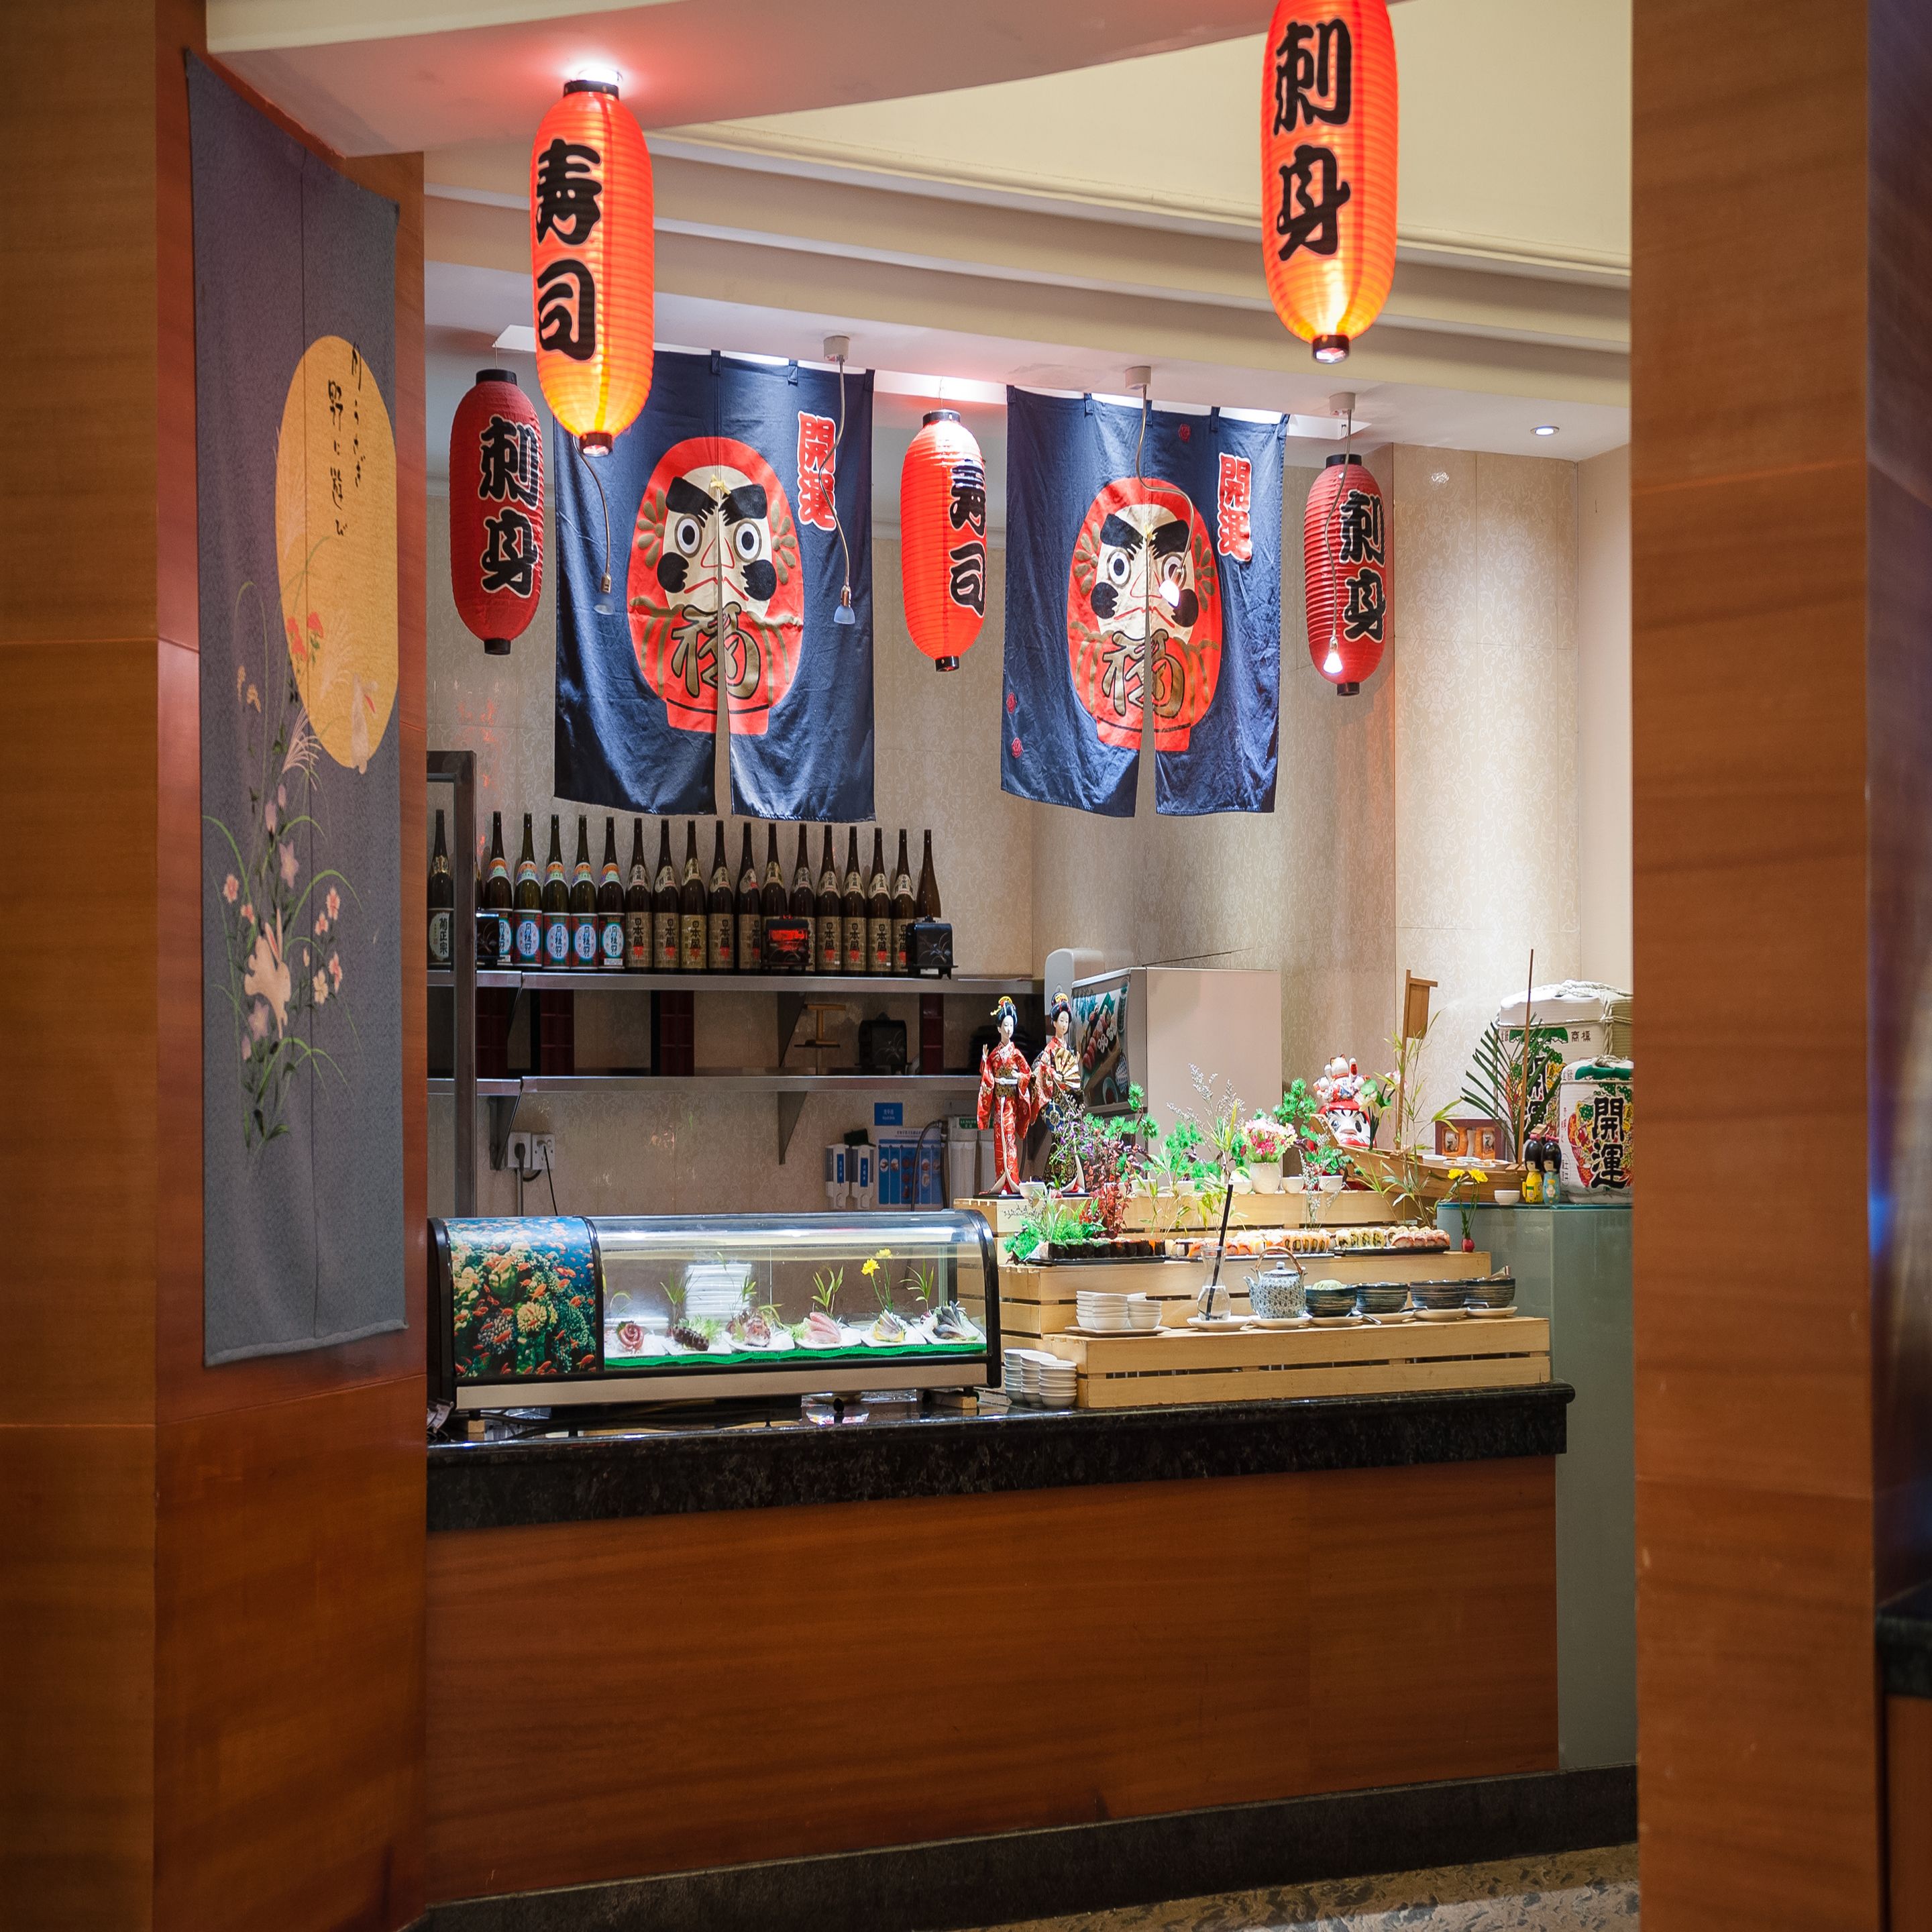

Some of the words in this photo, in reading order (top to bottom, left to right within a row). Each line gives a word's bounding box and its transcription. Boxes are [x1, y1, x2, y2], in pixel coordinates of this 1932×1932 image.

[1273, 18, 1352, 262] 刺身
[536, 138, 602, 362] 寿司
[479, 415, 539, 598] 刺身
[1339, 490, 1387, 644] 刺身
[671, 601, 761, 700] 福
[1102, 629, 1186, 719] 福
[439, 918, 448, 956] 菊正宗
[1570, 1030, 1593, 1042] 商標
[1590, 1096, 1628, 1189] 開運
